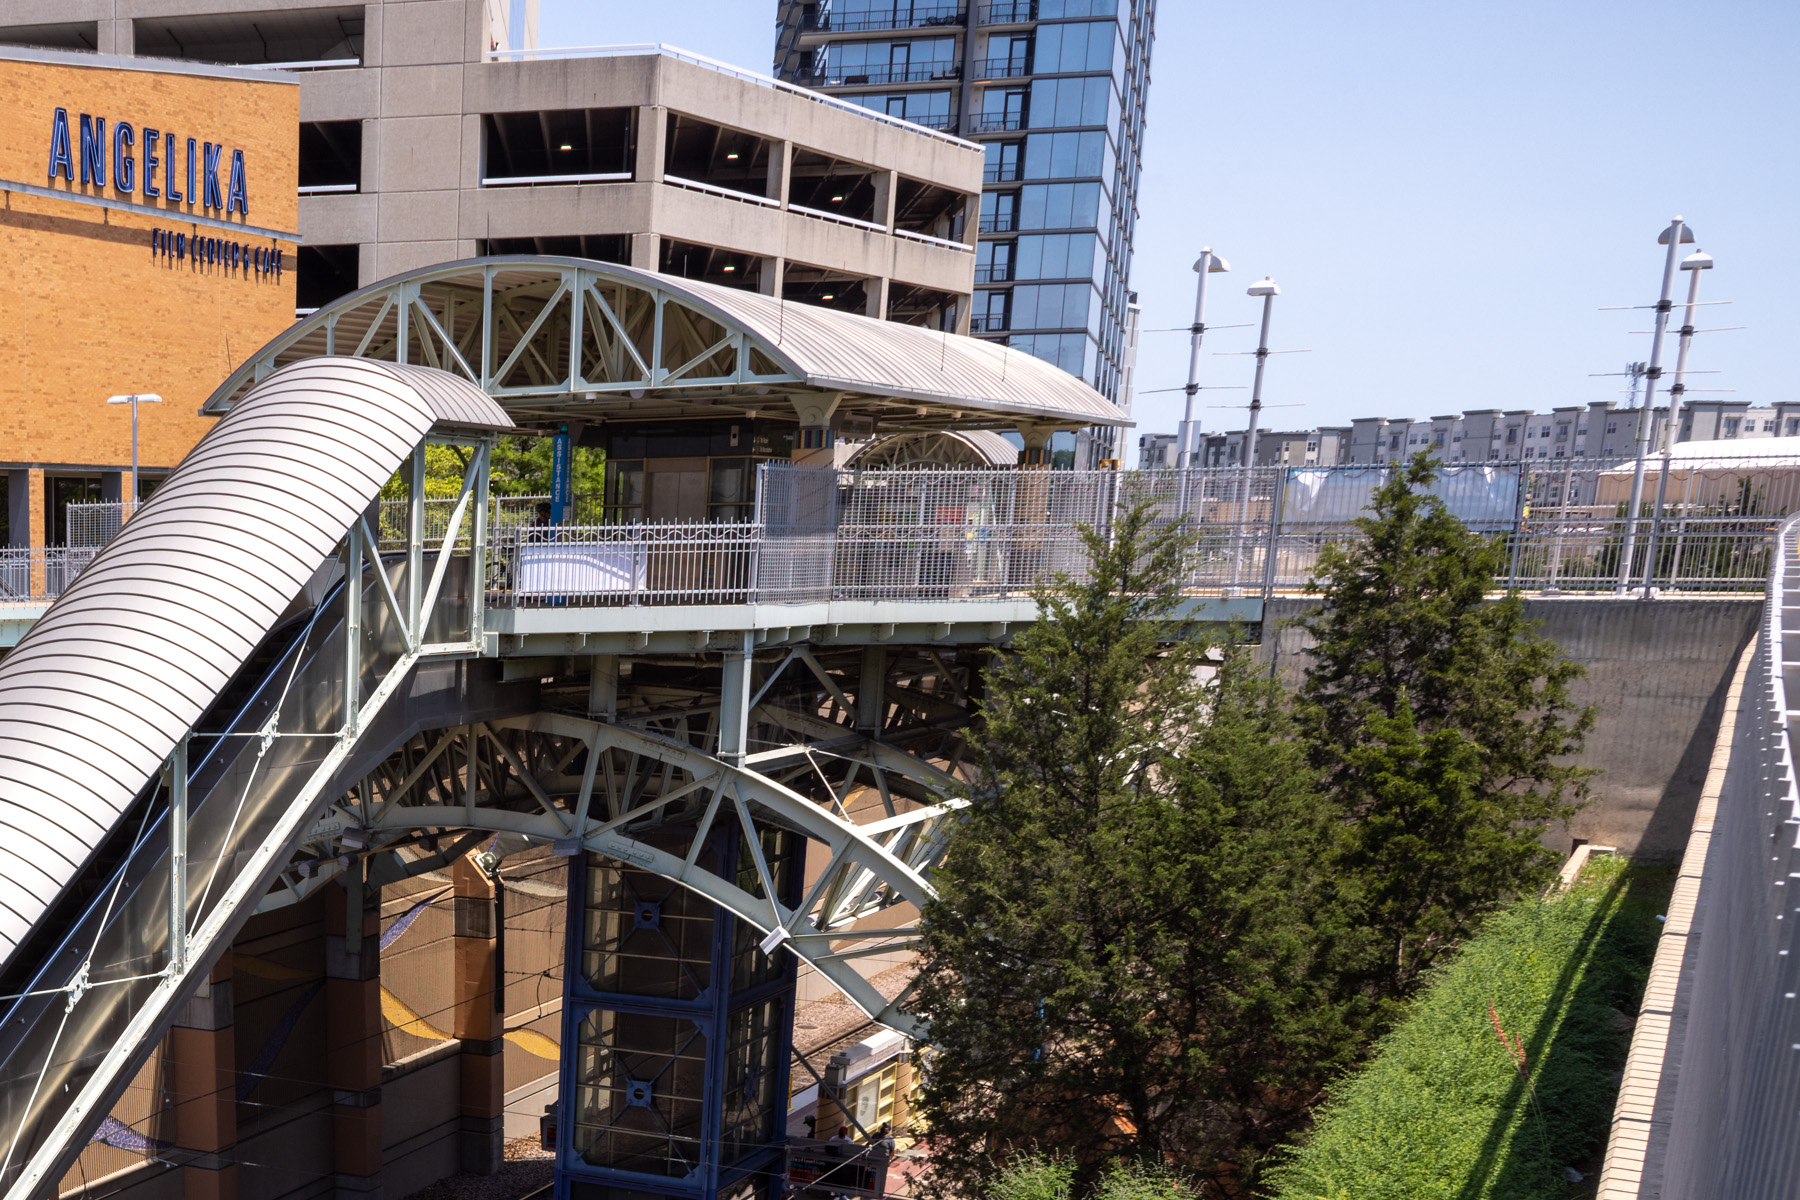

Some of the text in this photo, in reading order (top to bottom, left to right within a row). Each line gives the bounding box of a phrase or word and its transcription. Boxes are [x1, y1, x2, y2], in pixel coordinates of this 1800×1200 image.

[48, 107, 248, 214] ANGELIKA
[152, 227, 185, 259] FILM
[191, 234, 239, 268] CENTER
[554, 438, 562, 503] ASSISTANCE
